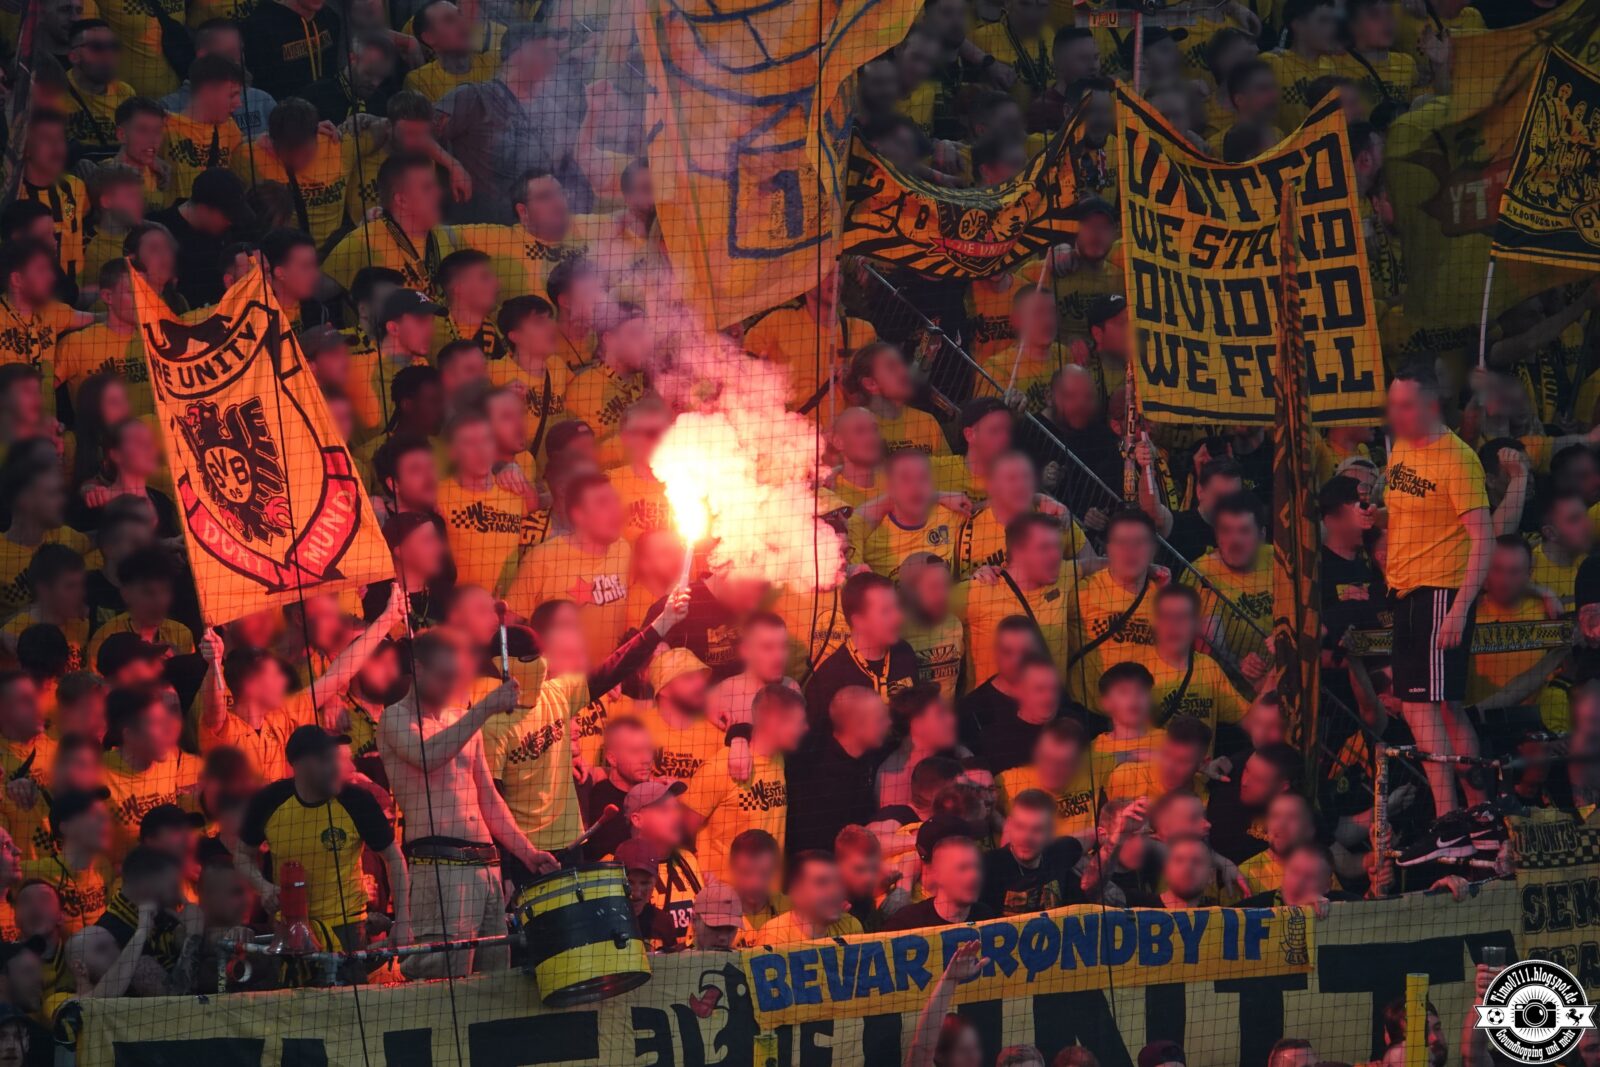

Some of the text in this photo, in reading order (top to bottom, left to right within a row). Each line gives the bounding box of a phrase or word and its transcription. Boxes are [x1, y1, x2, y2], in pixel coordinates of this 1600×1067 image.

[1128, 199, 1186, 263] WE
[1188, 207, 1357, 269] STAND
[1131, 257, 1367, 337] DIVIDED
[177, 321, 258, 389] UNITY
[1135, 327, 1218, 395] WE
[207, 448, 250, 488] BVB
[229, 487, 244, 499] 09
[303, 489, 356, 566] MUND
[749, 906, 1276, 1013] BEVAR BRØNDBY IF
